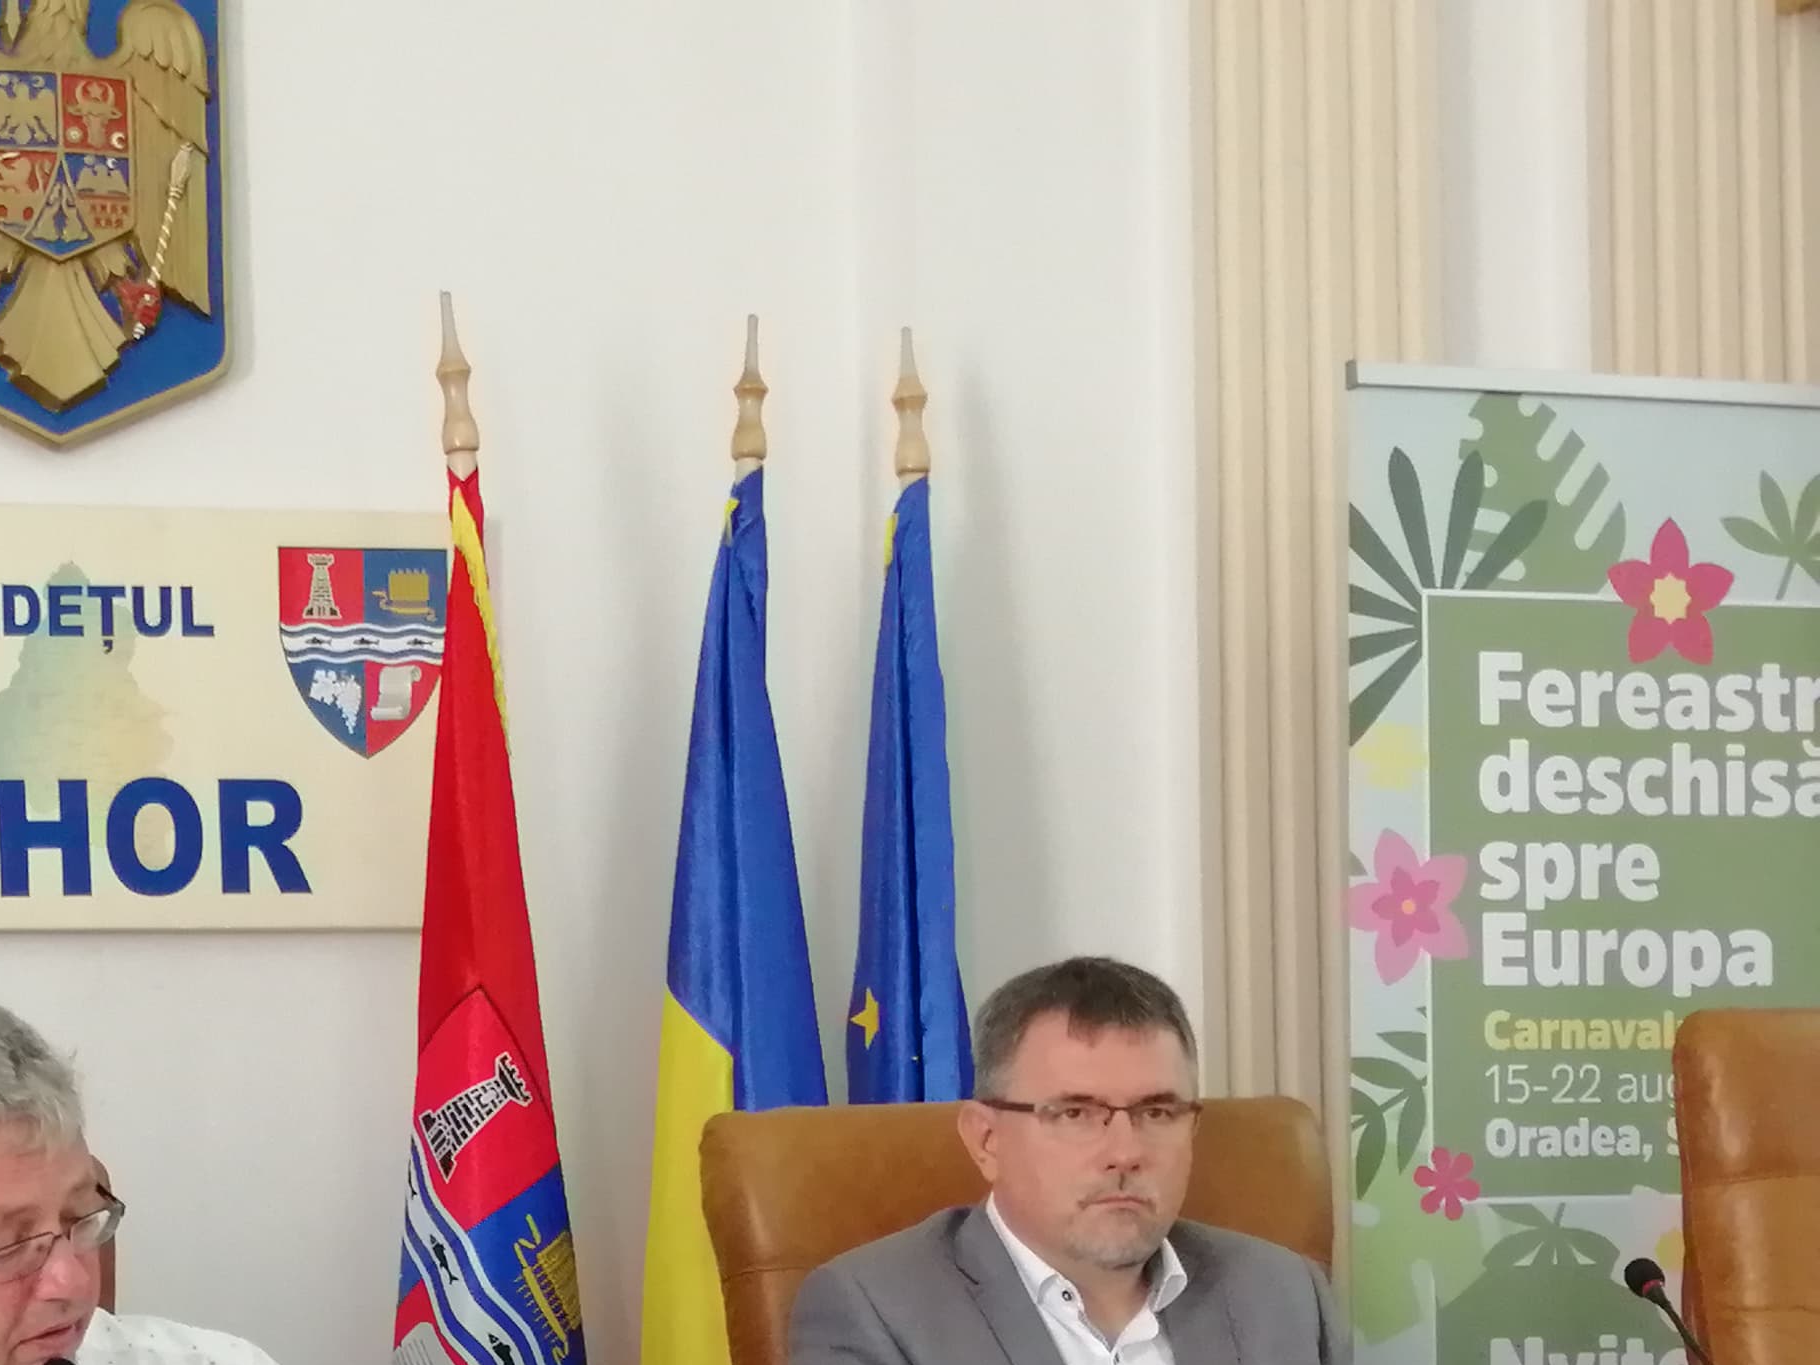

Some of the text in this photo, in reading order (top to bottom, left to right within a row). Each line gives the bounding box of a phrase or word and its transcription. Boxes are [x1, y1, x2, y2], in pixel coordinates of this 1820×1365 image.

[1479, 841, 1660, 911] spre
[1482, 912, 1774, 998] Europa
[1483, 1009, 1685, 1051] Carnaval
[1484, 1063, 1602, 1104] 15-22
[1484, 1117, 1654, 1163] Oradea,
